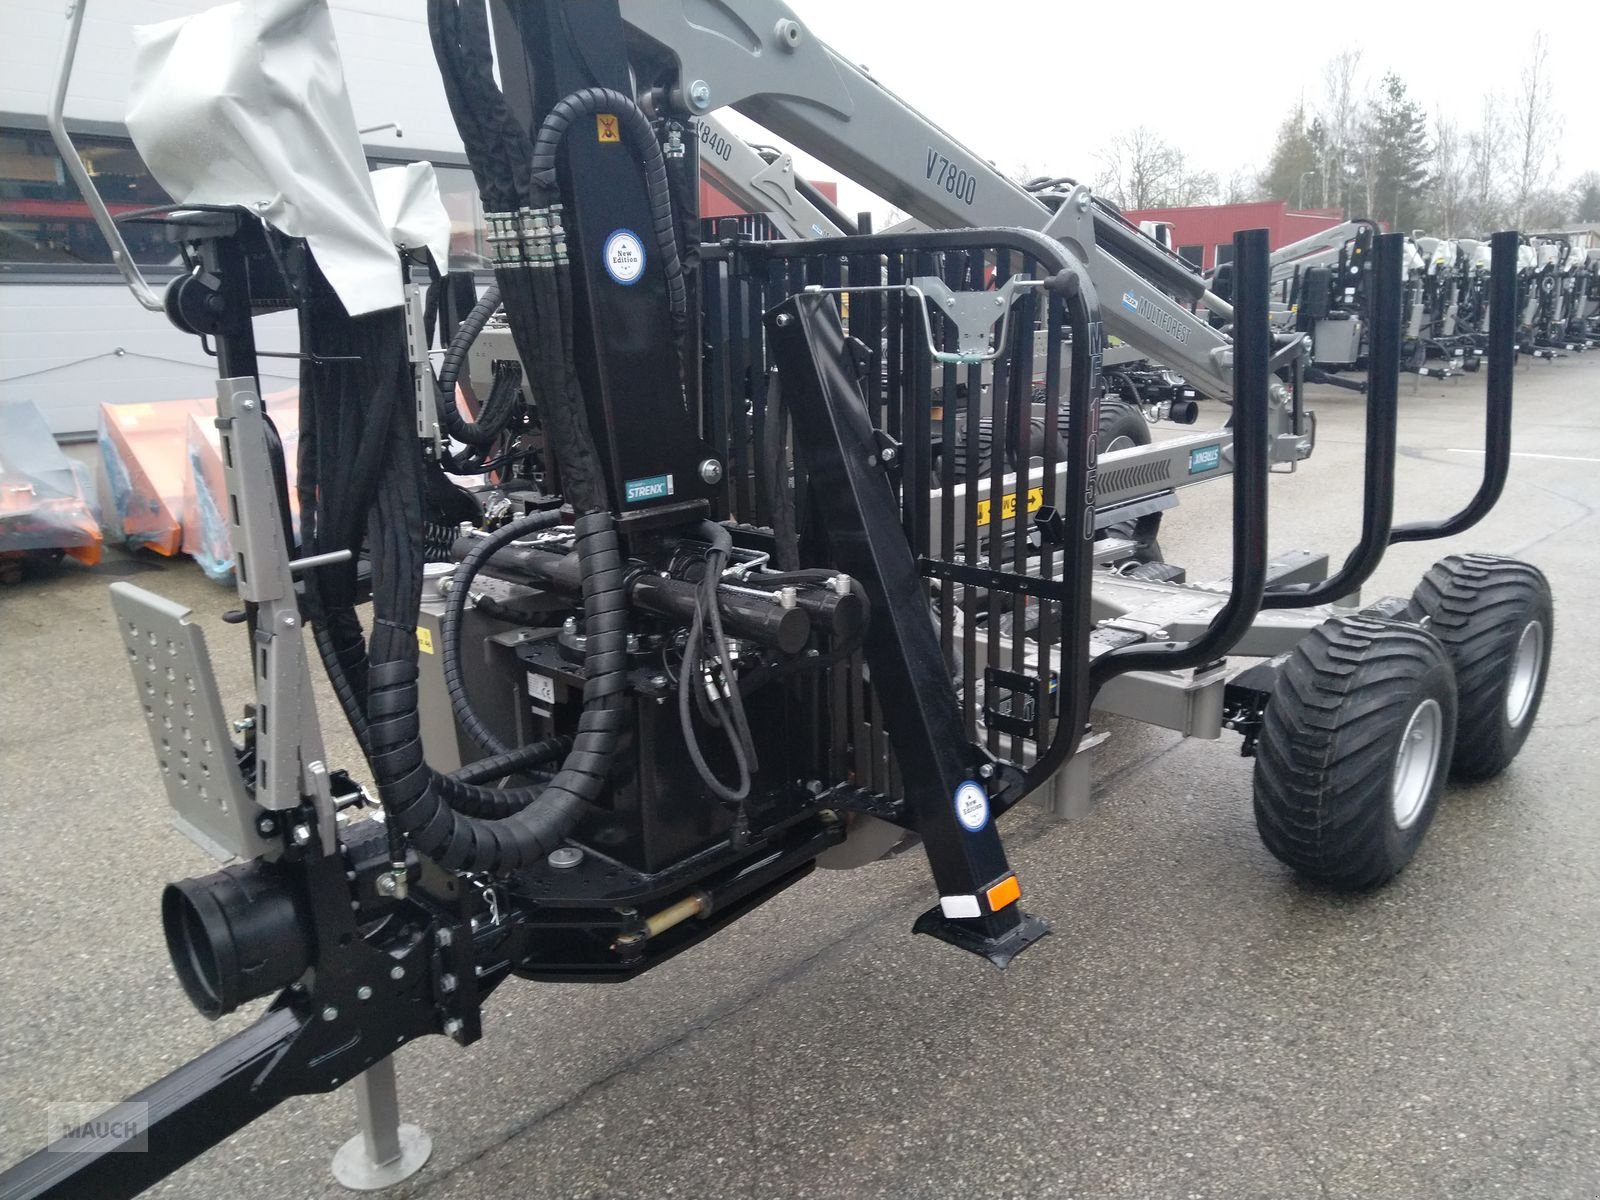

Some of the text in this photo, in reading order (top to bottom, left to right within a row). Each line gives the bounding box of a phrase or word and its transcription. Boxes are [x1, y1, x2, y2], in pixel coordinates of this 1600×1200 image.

[926, 147, 976, 205] V7800
[612, 256, 638, 264] Edition
[1138, 296, 1191, 345] MULTIFOREST
[627, 484, 663, 499] STRENX
